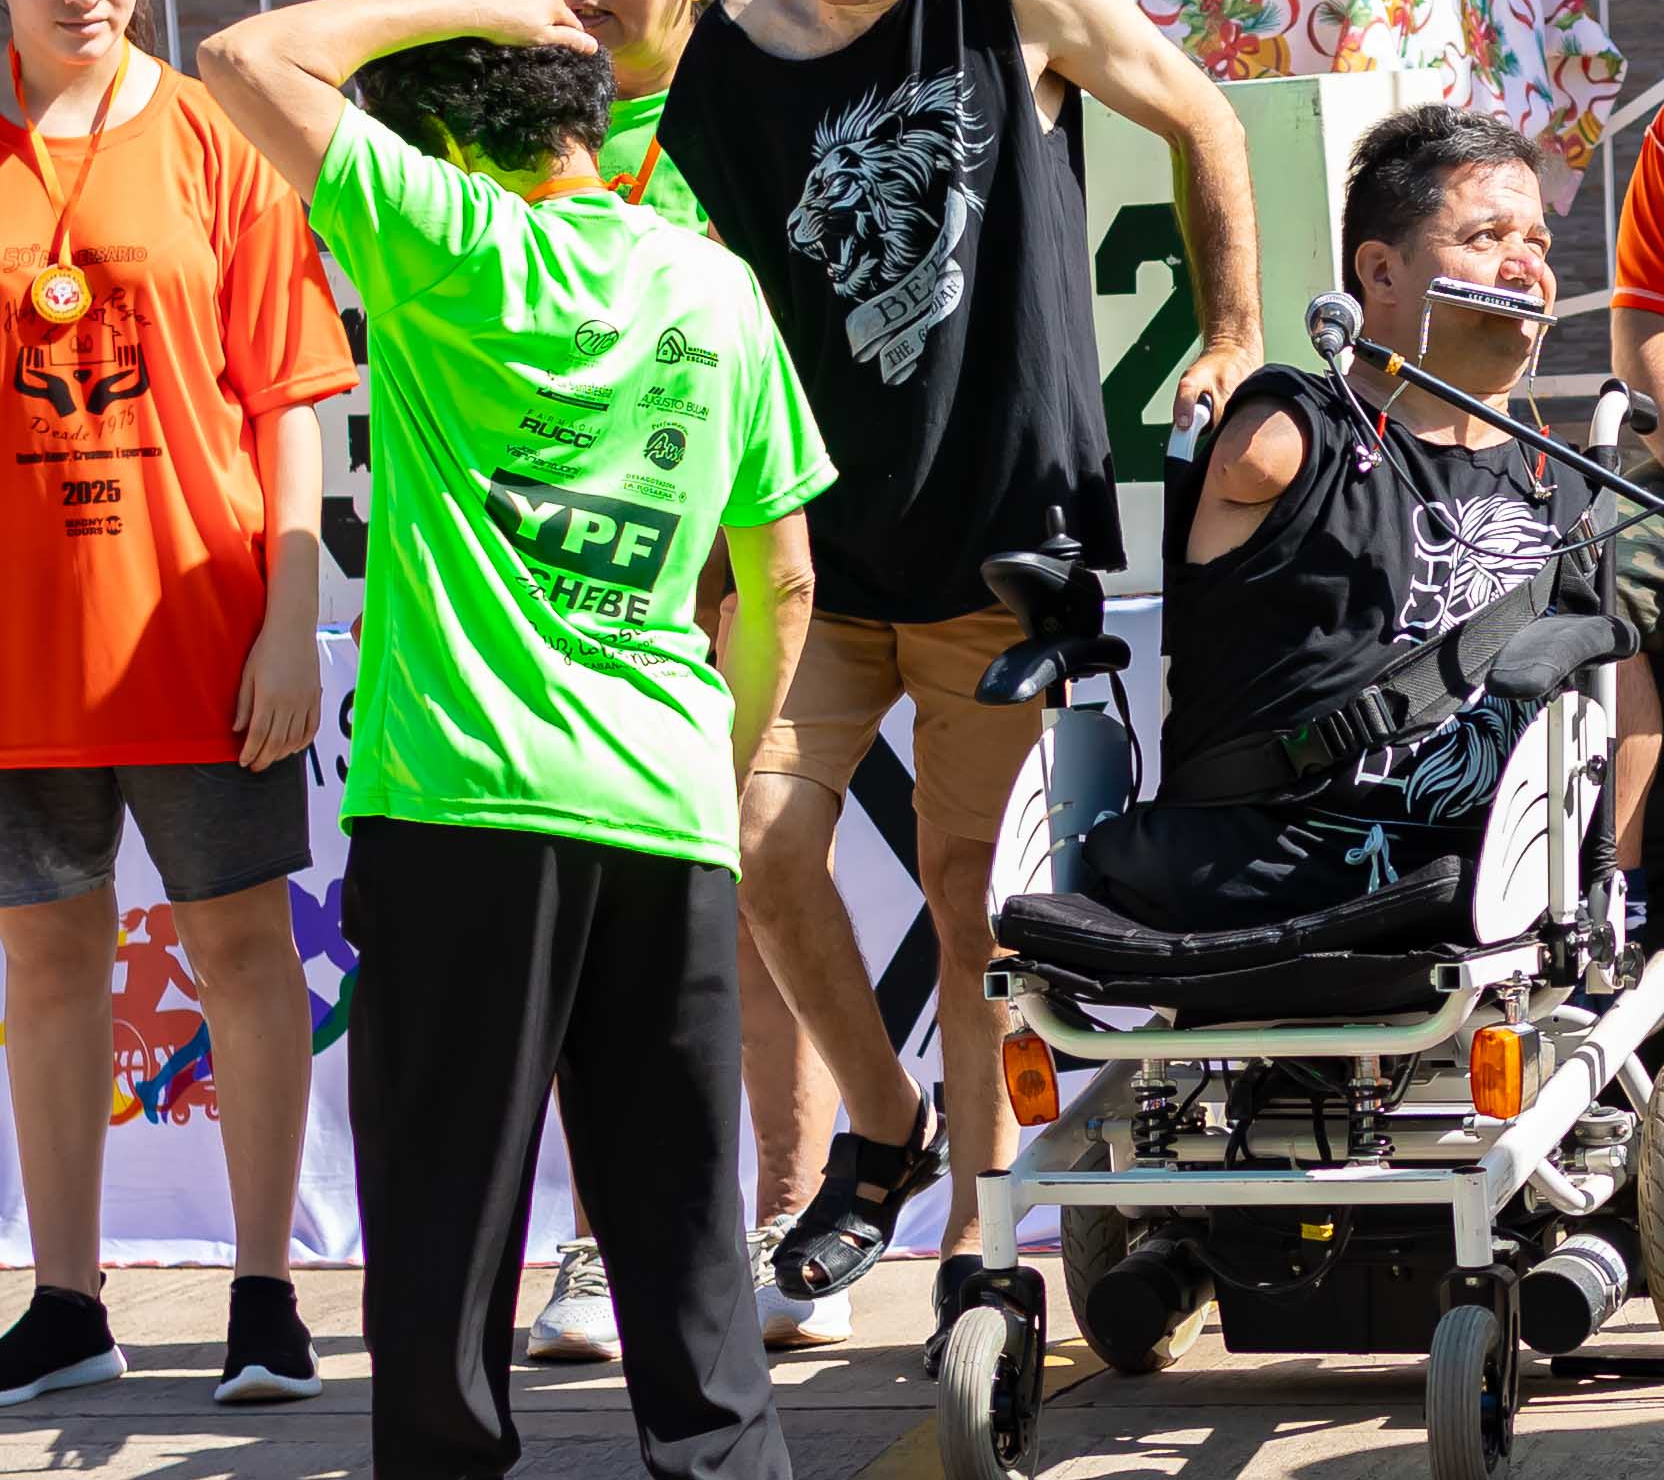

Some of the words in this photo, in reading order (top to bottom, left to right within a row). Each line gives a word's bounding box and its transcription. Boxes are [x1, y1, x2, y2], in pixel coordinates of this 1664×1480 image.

[885, 339, 915, 367] THE
[918, 278, 961, 344] GDIAN
[642, 394, 684, 410] AUGUSTO
[519, 416, 597, 449] RUCCI
[62, 480, 121, 505] 2025
[505, 489, 660, 567] YPF
